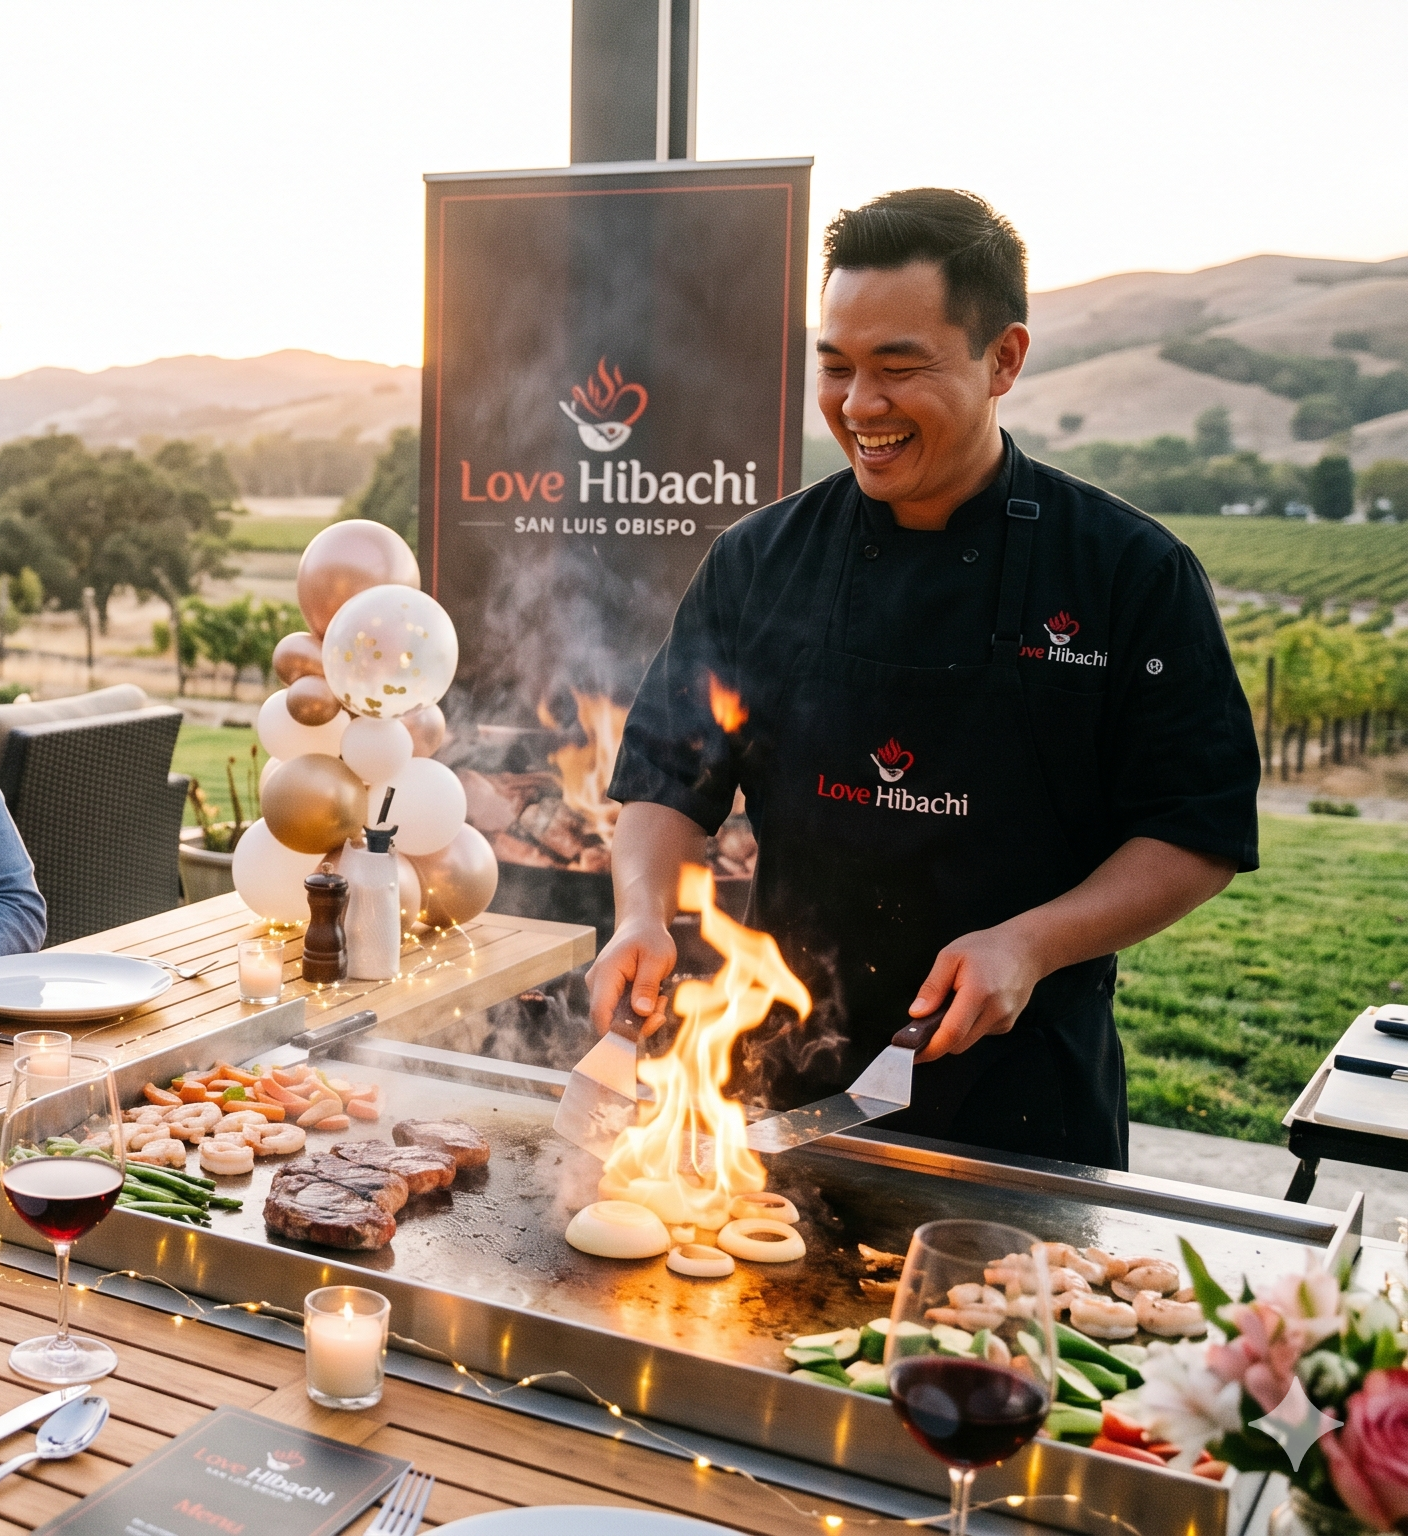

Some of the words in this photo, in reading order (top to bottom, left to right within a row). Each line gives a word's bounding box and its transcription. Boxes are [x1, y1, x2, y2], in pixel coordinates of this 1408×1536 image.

[460, 460, 565, 502] Love
[578, 459, 758, 505] Hibachi
[514, 516, 554, 533] SAN
[562, 517, 607, 535] LUIS
[615, 518, 696, 536] OBISPO
[1047, 646, 1108, 667] Hibachi
[817, 774, 870, 805] Love
[876, 785, 968, 816] Hibachi
